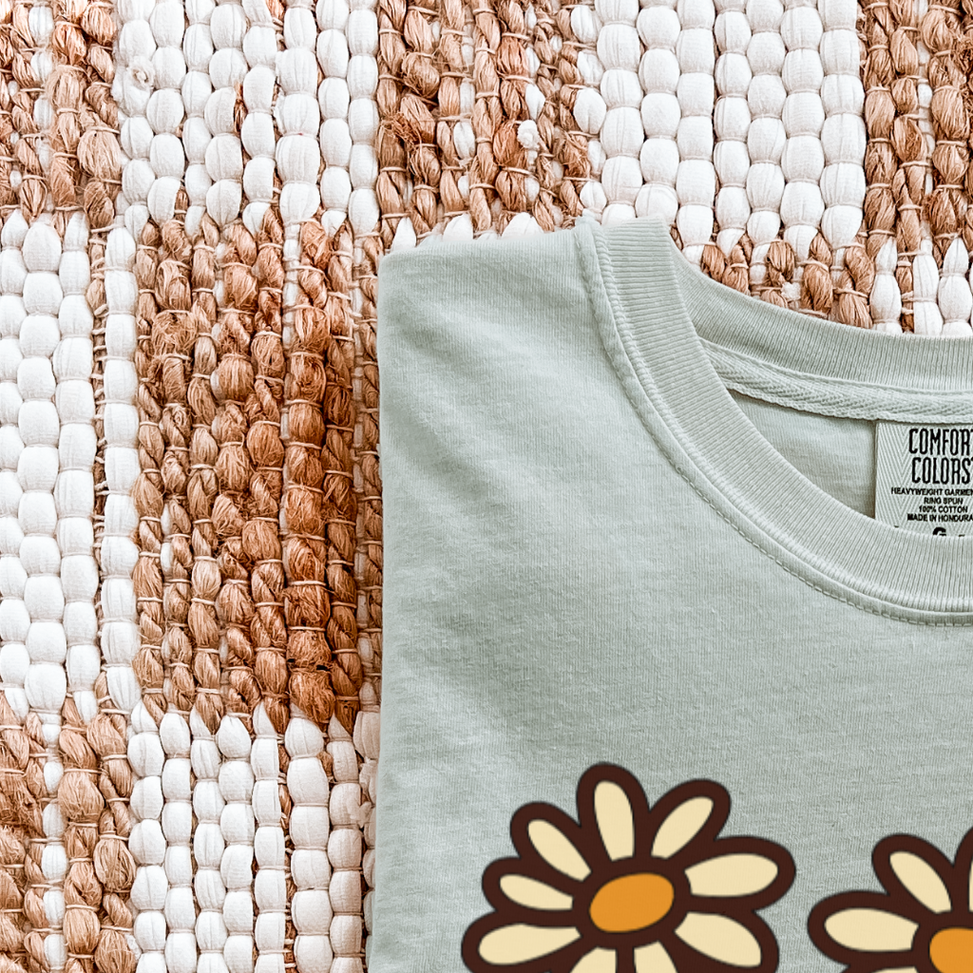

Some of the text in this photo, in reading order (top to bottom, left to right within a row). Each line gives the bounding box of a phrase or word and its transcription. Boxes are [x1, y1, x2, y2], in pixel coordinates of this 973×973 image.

[891, 487, 943, 496] HEAVYWEIGHT
[924, 497, 963, 505] RING SPUN
[919, 505, 968, 513] 100% COTTON
[907, 514, 928, 522] MADE
[930, 514, 937, 522] IN
